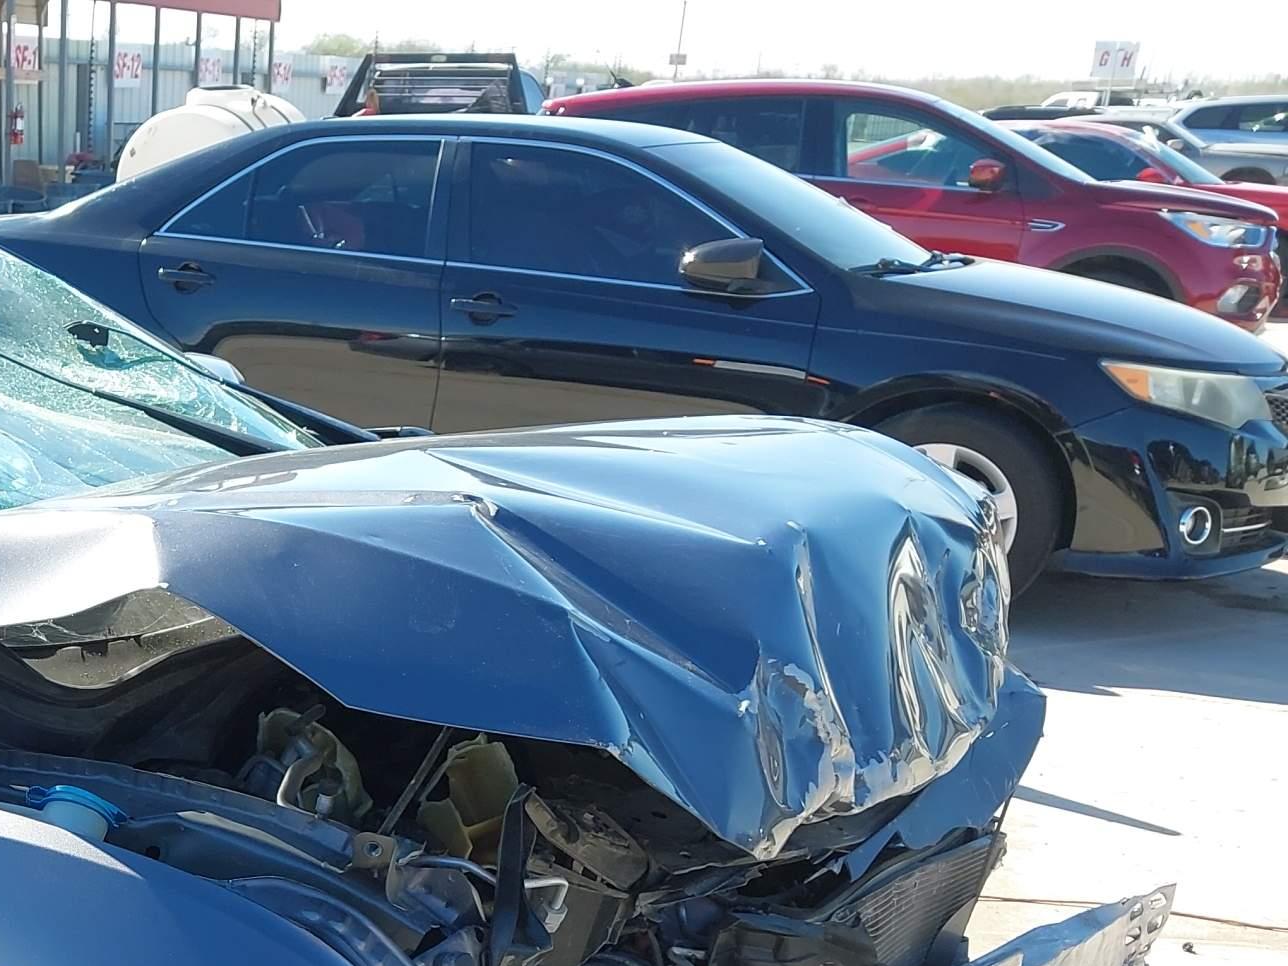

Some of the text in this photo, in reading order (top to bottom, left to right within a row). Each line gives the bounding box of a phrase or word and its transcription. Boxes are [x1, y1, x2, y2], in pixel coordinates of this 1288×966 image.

[114, 51, 142, 79] SF-12
[1099, 50, 1111, 67] G
[1120, 50, 1134, 67] H
